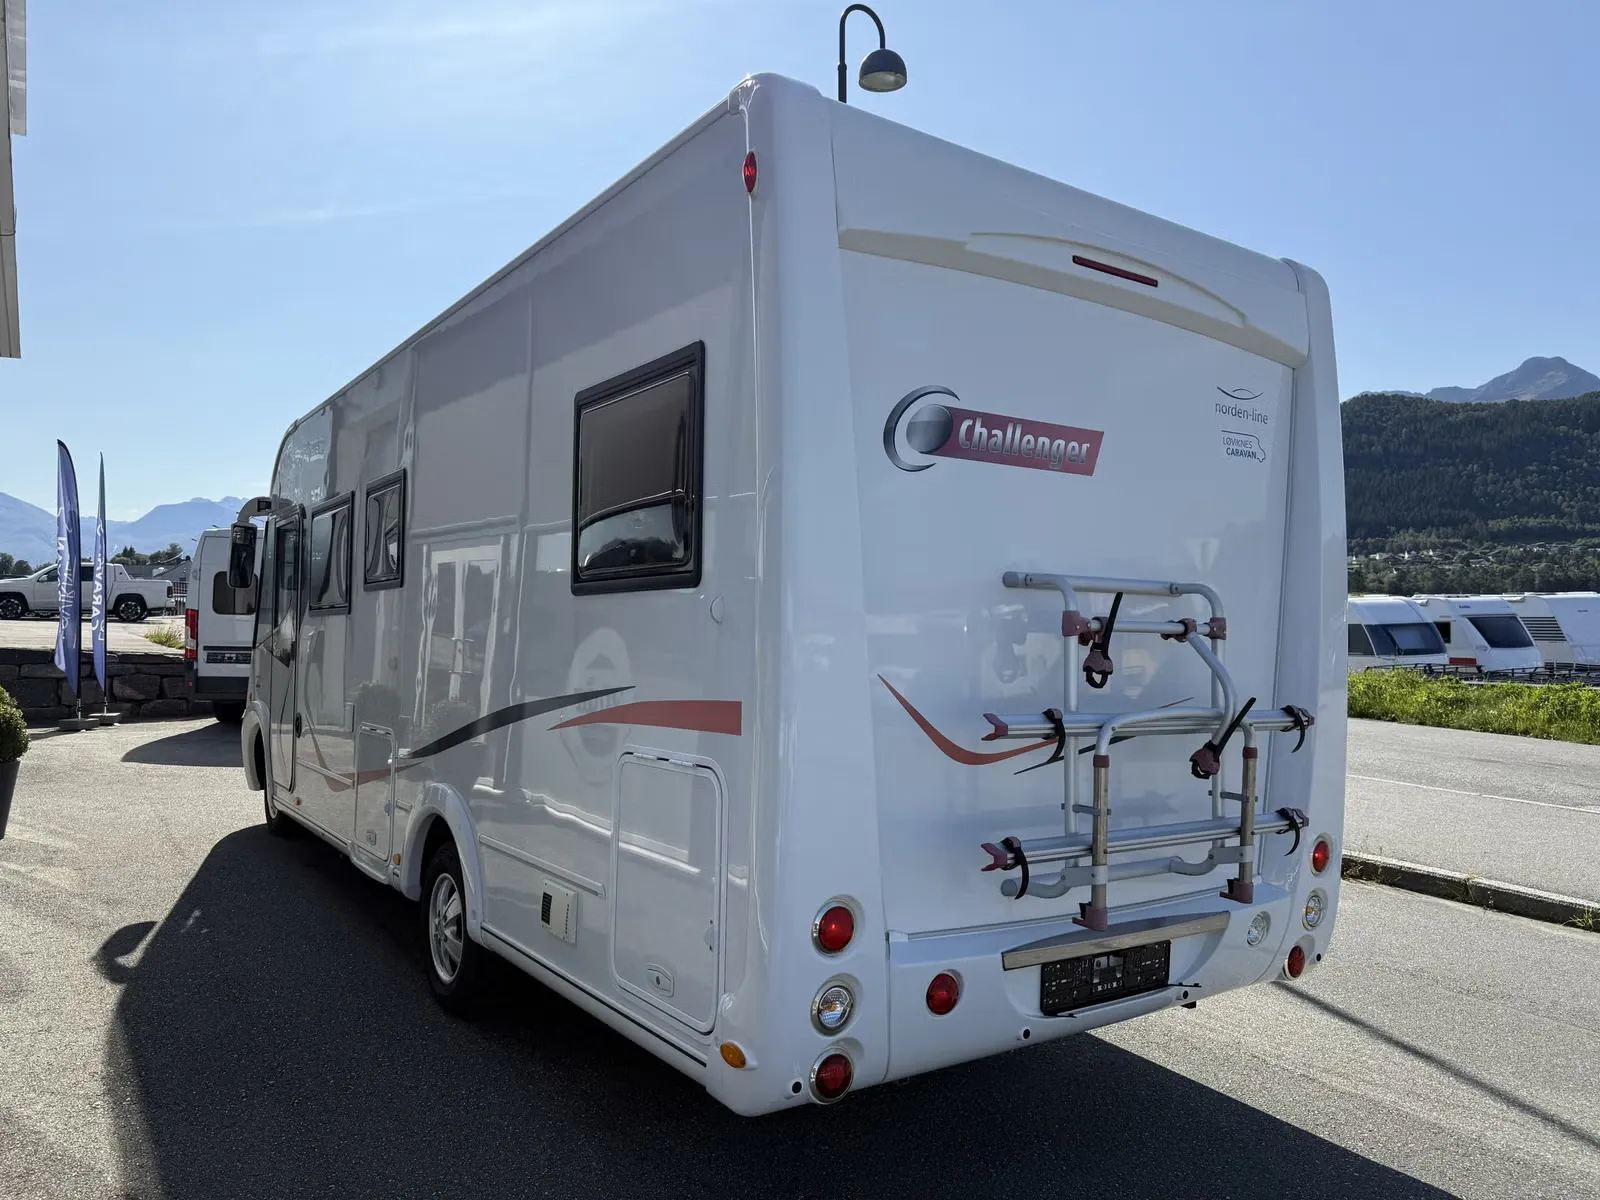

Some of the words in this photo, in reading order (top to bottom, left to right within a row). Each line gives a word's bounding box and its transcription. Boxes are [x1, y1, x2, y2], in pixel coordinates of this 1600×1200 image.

[1215, 402, 1269, 425] norden-line
[958, 416, 1091, 469] Challenger
[1222, 437, 1253, 449] LØVIKNES
[1226, 447, 1257, 460] CARAVAN
